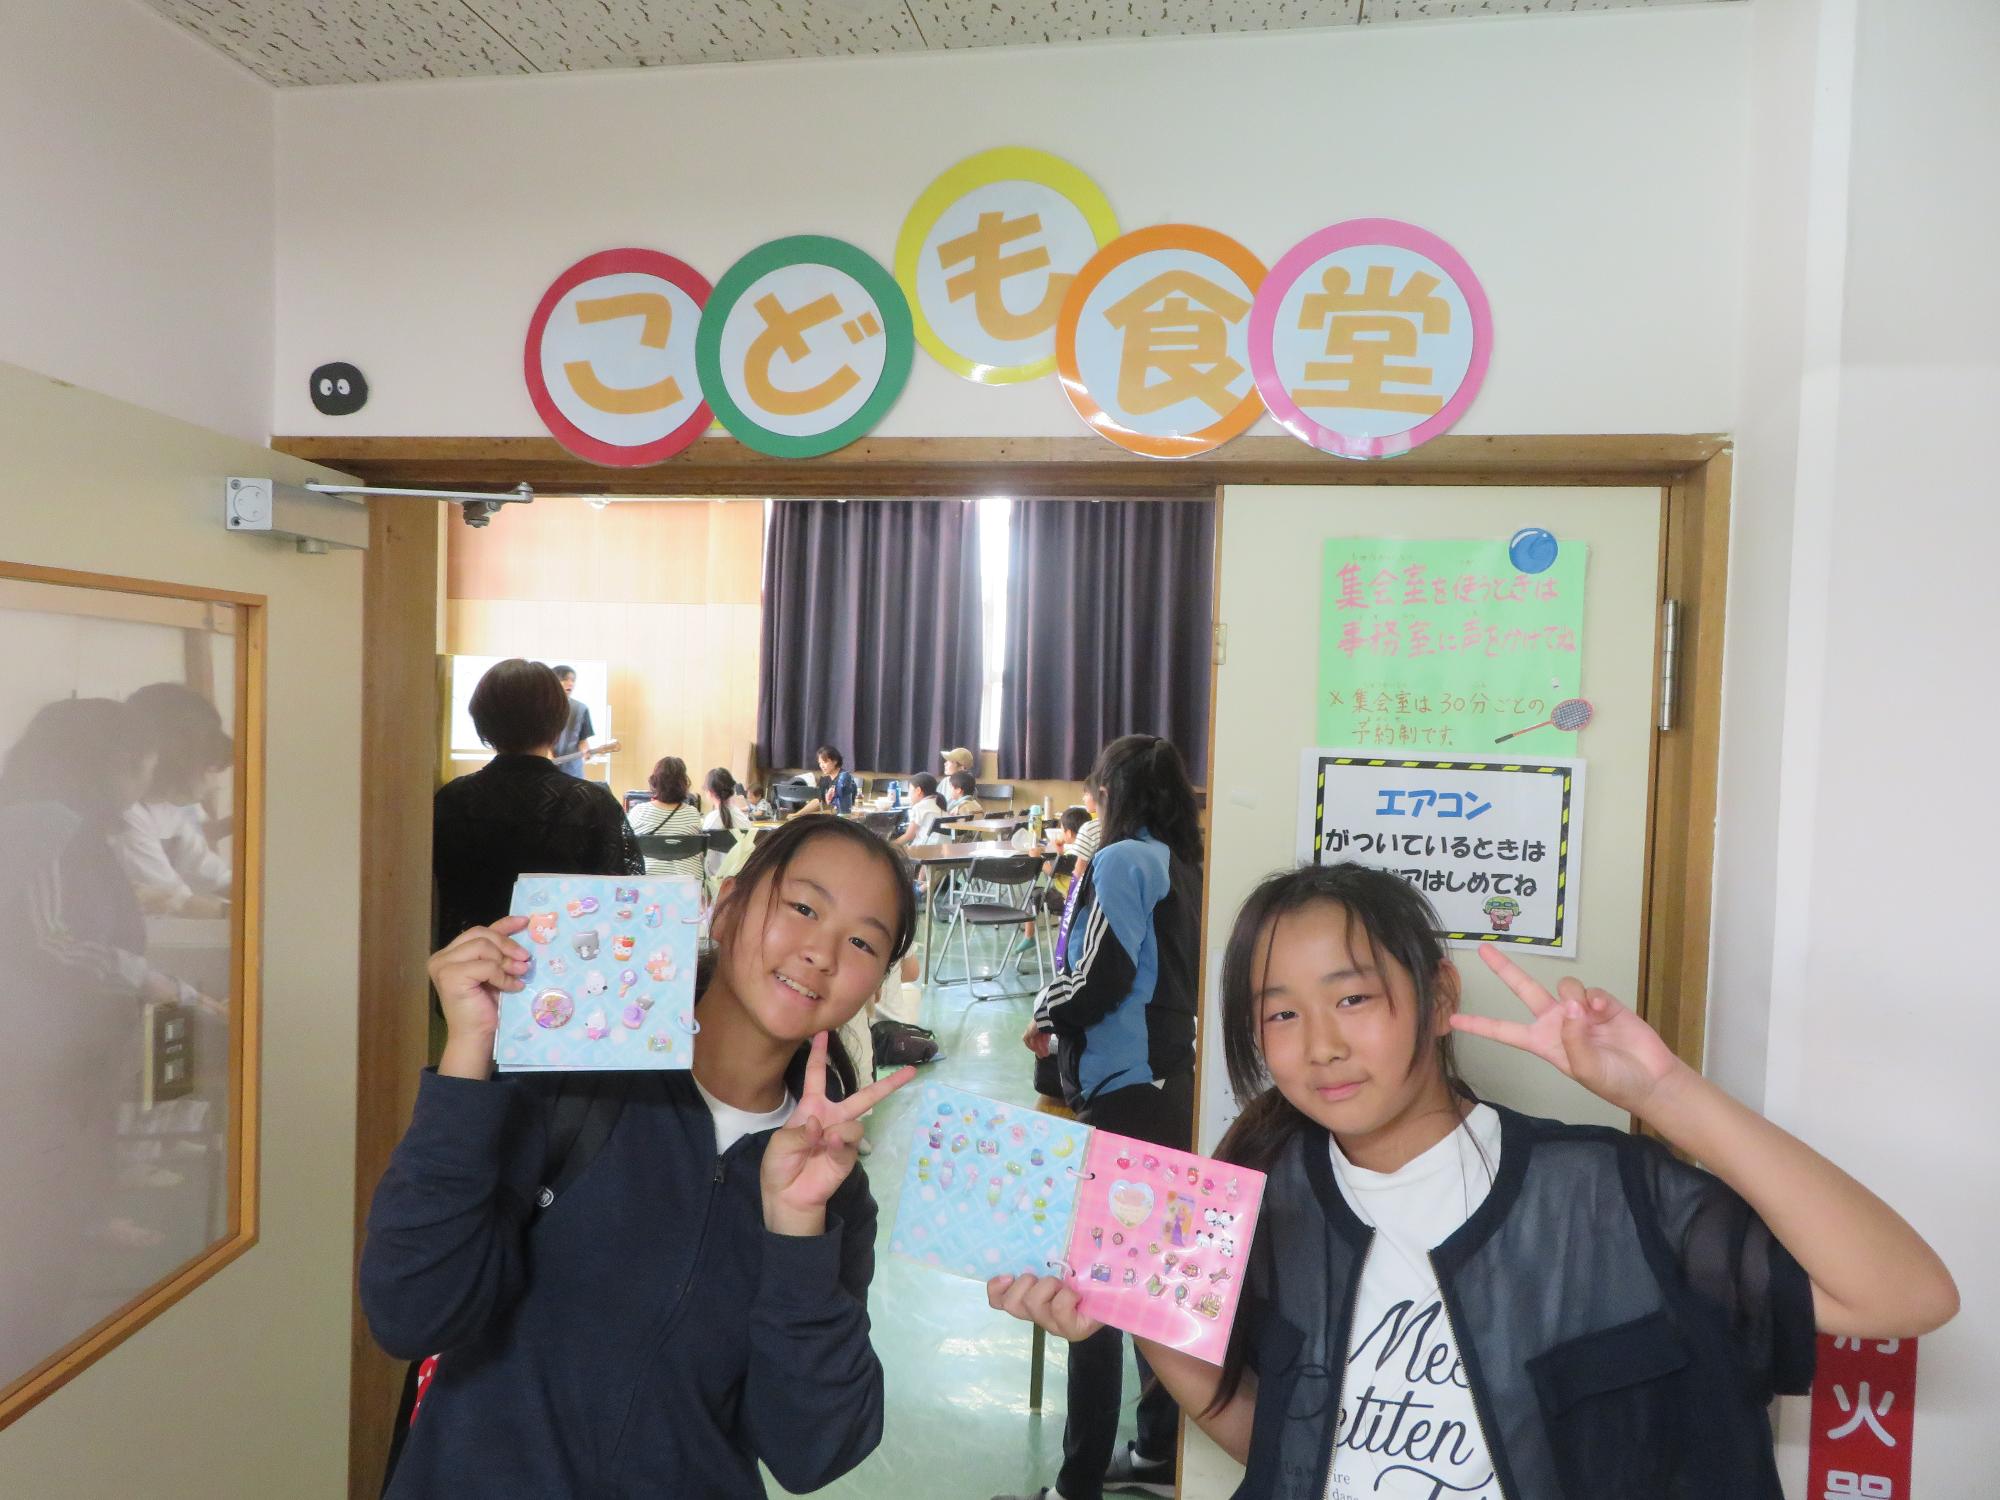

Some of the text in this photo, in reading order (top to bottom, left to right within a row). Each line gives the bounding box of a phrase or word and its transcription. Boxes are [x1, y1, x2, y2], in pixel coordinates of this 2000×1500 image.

[563, 211, 1452, 419] こども食堂
[1375, 789, 1493, 821] エアコン
[1325, 828, 1546, 863] がついているときは
[1383, 867, 1538, 897] アはしめてね
